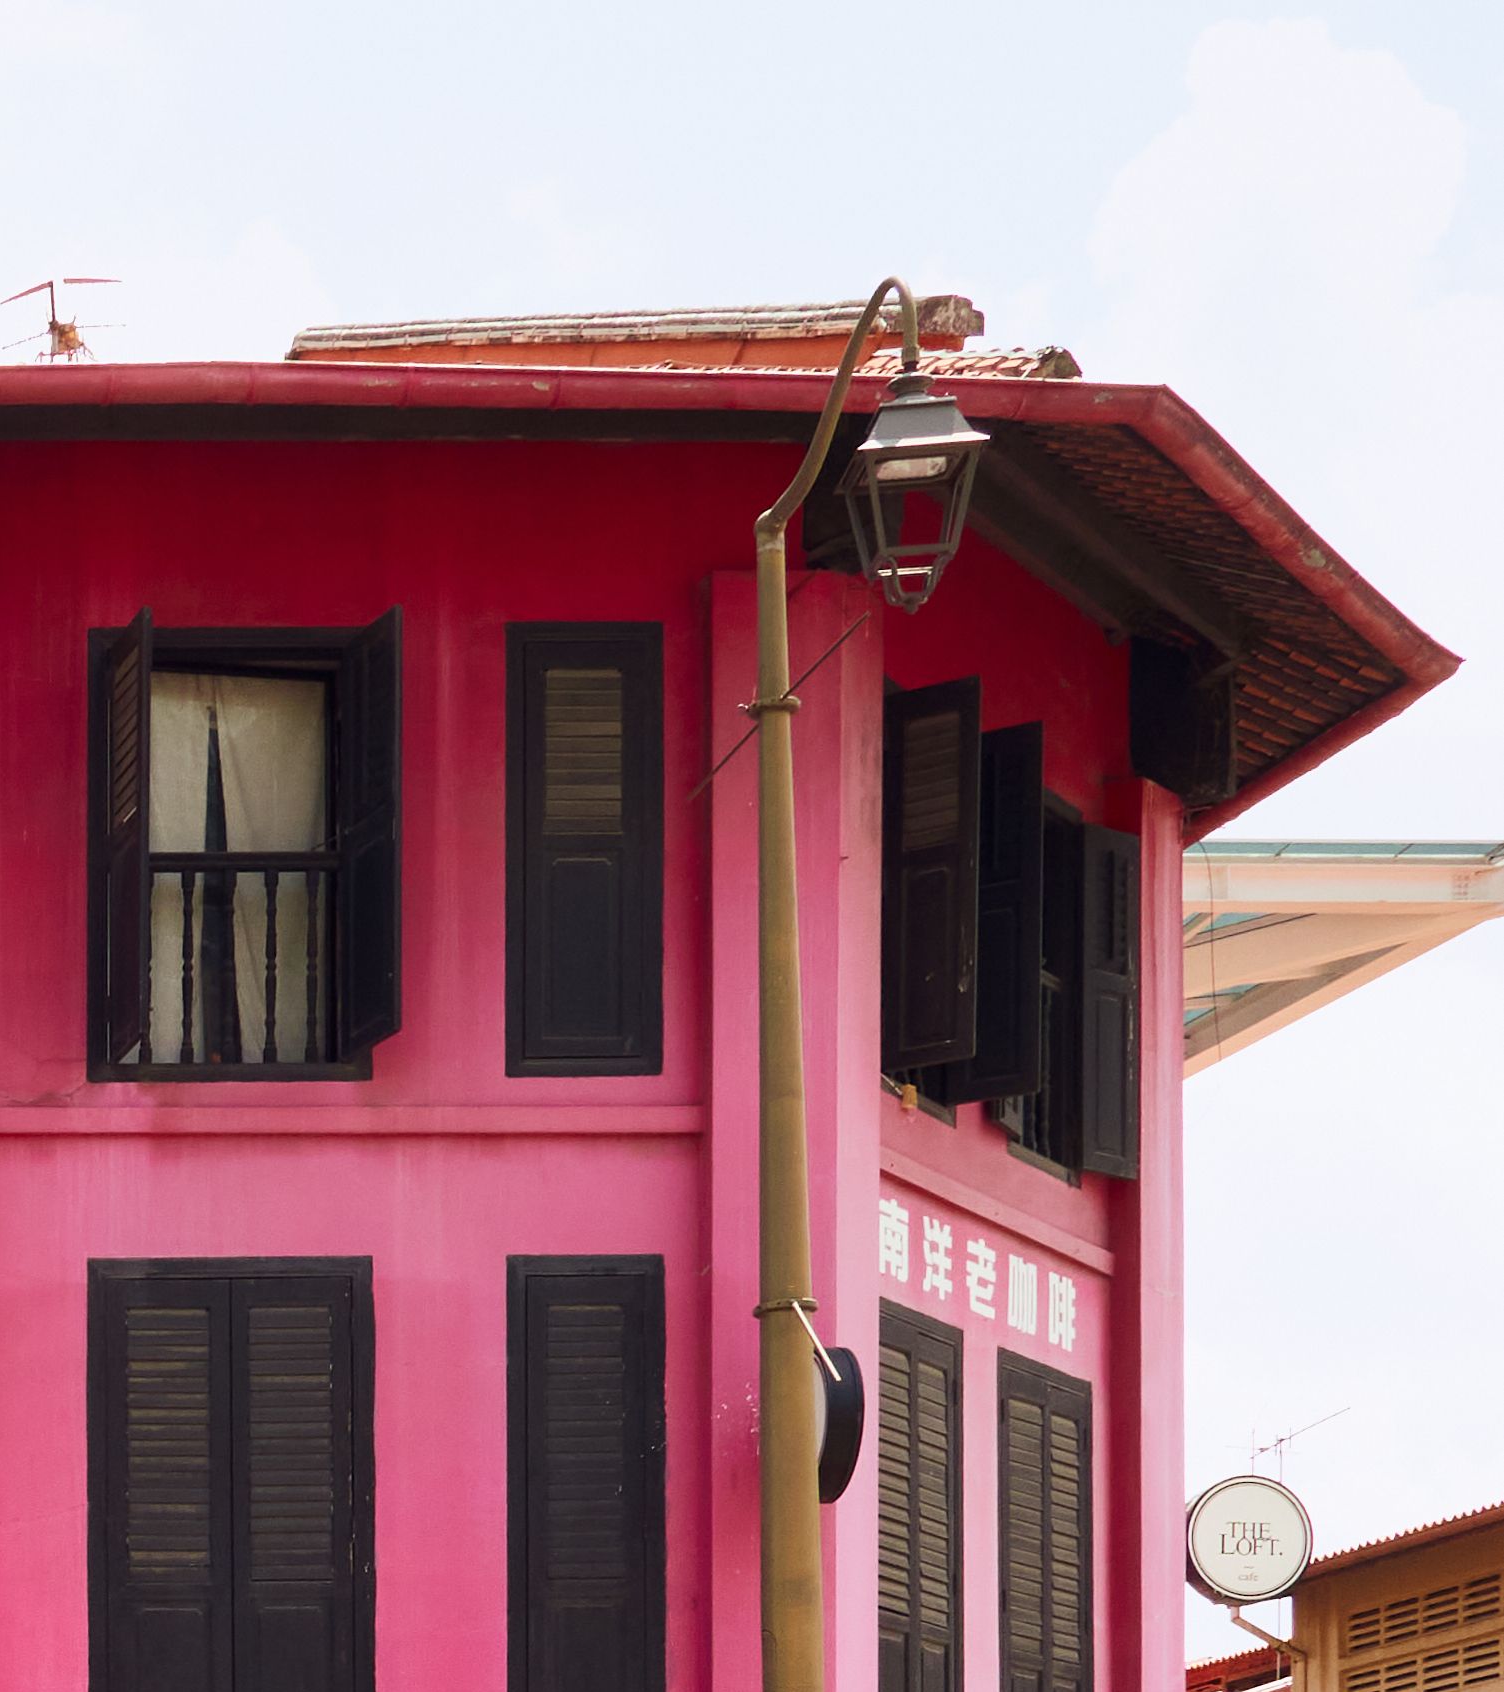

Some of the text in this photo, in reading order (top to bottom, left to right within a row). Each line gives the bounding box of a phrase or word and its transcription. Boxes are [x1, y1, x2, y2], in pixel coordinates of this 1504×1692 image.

[879, 1198, 1077, 1352] 南洋老咖啡
[1226, 1521, 1271, 1540] THE
